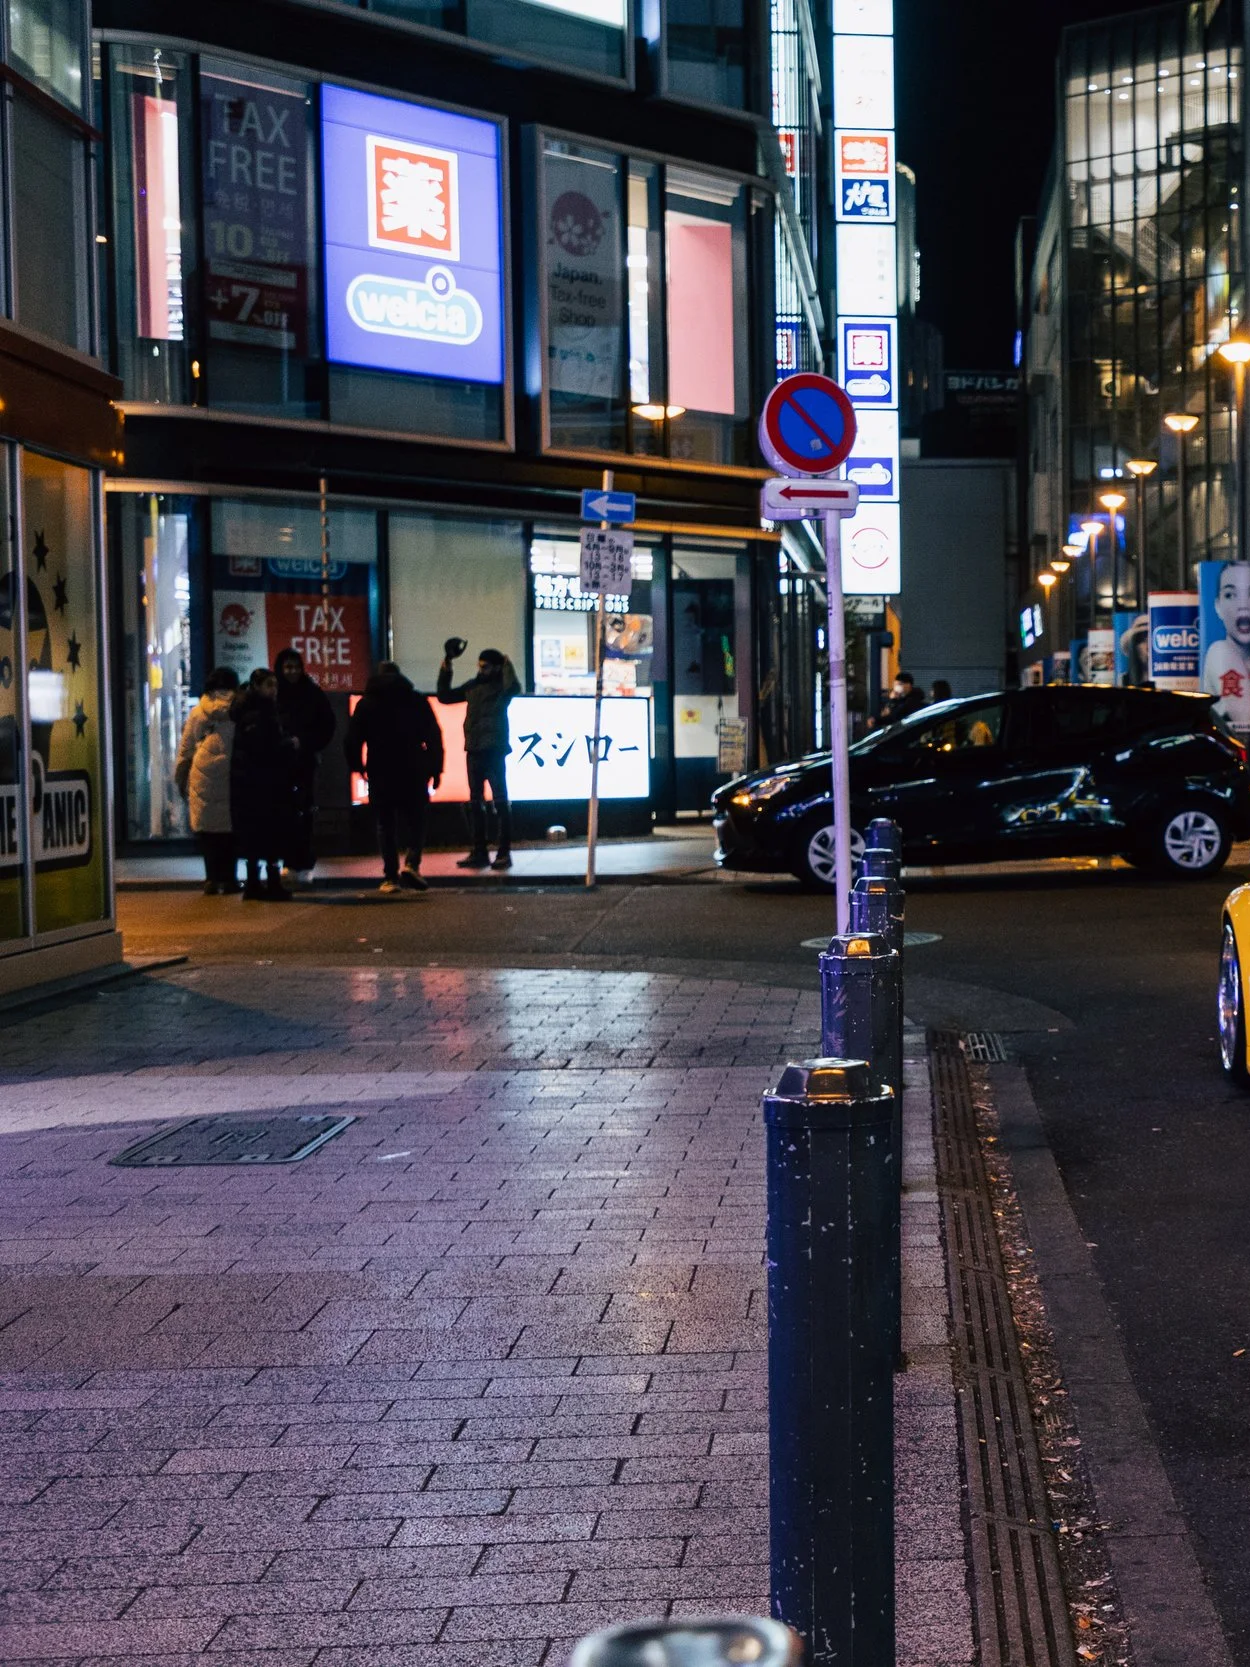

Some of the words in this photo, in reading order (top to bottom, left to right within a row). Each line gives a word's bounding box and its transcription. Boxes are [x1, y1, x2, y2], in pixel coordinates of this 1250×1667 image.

[215, 93, 290, 147] TAX
[208, 140, 298, 195] FREE
[210, 220, 254, 258] 10
[357, 280, 469, 336] welcia
[558, 307, 596, 328] Shop
[274, 558, 338, 574] welca
[295, 604, 345, 633] TAX
[535, 596, 630, 613] PRESCRIPTONS
[291, 636, 351, 665] FREE
[518, 731, 640, 768] スシロー
